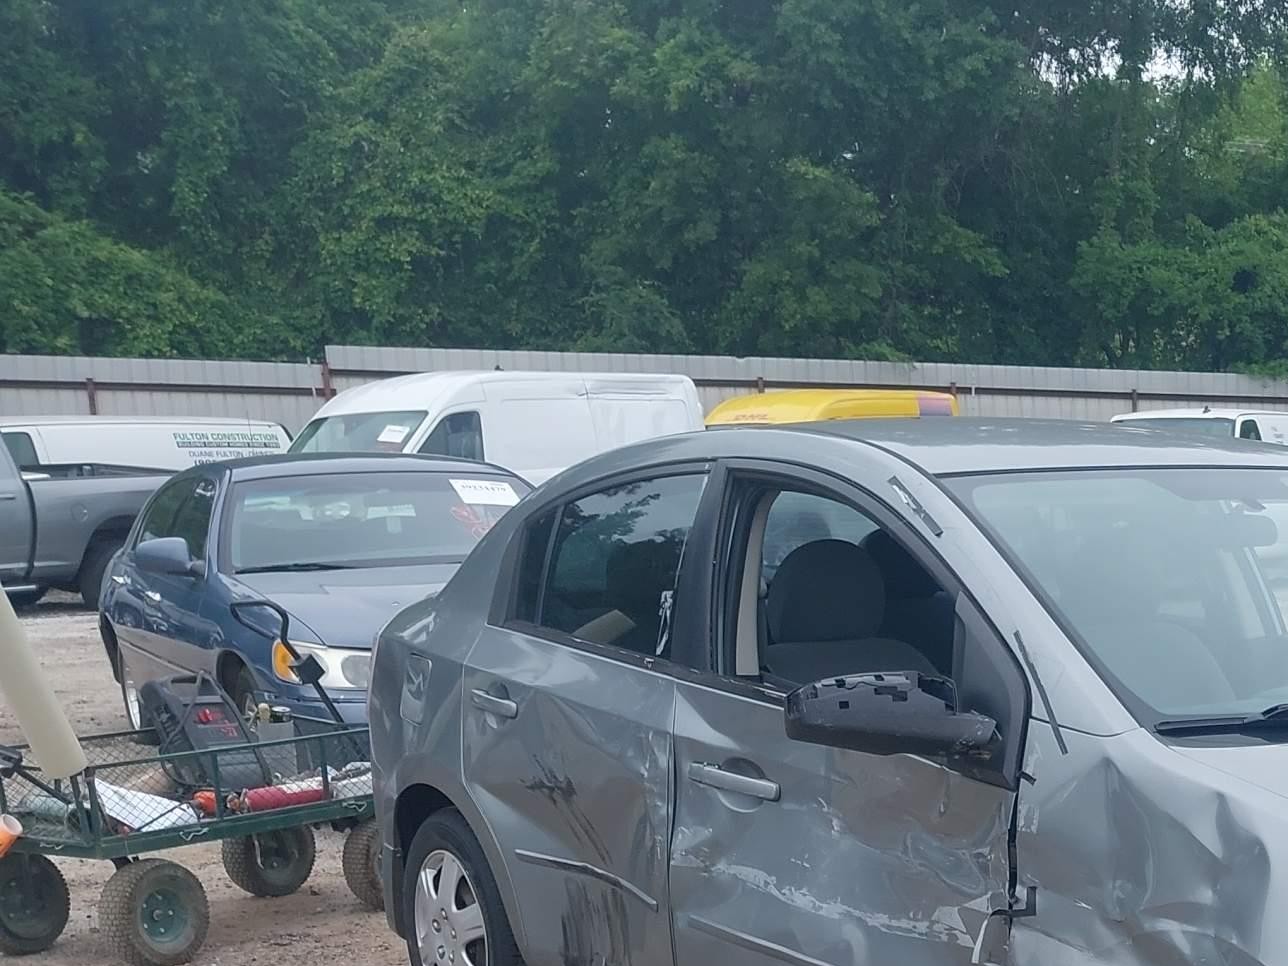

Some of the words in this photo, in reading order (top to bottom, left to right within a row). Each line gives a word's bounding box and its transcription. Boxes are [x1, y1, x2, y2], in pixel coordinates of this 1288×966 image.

[173, 432, 209, 440] FULTON
[211, 432, 279, 441] CONSTRUCTION
[215, 451, 244, 459] FULTON
